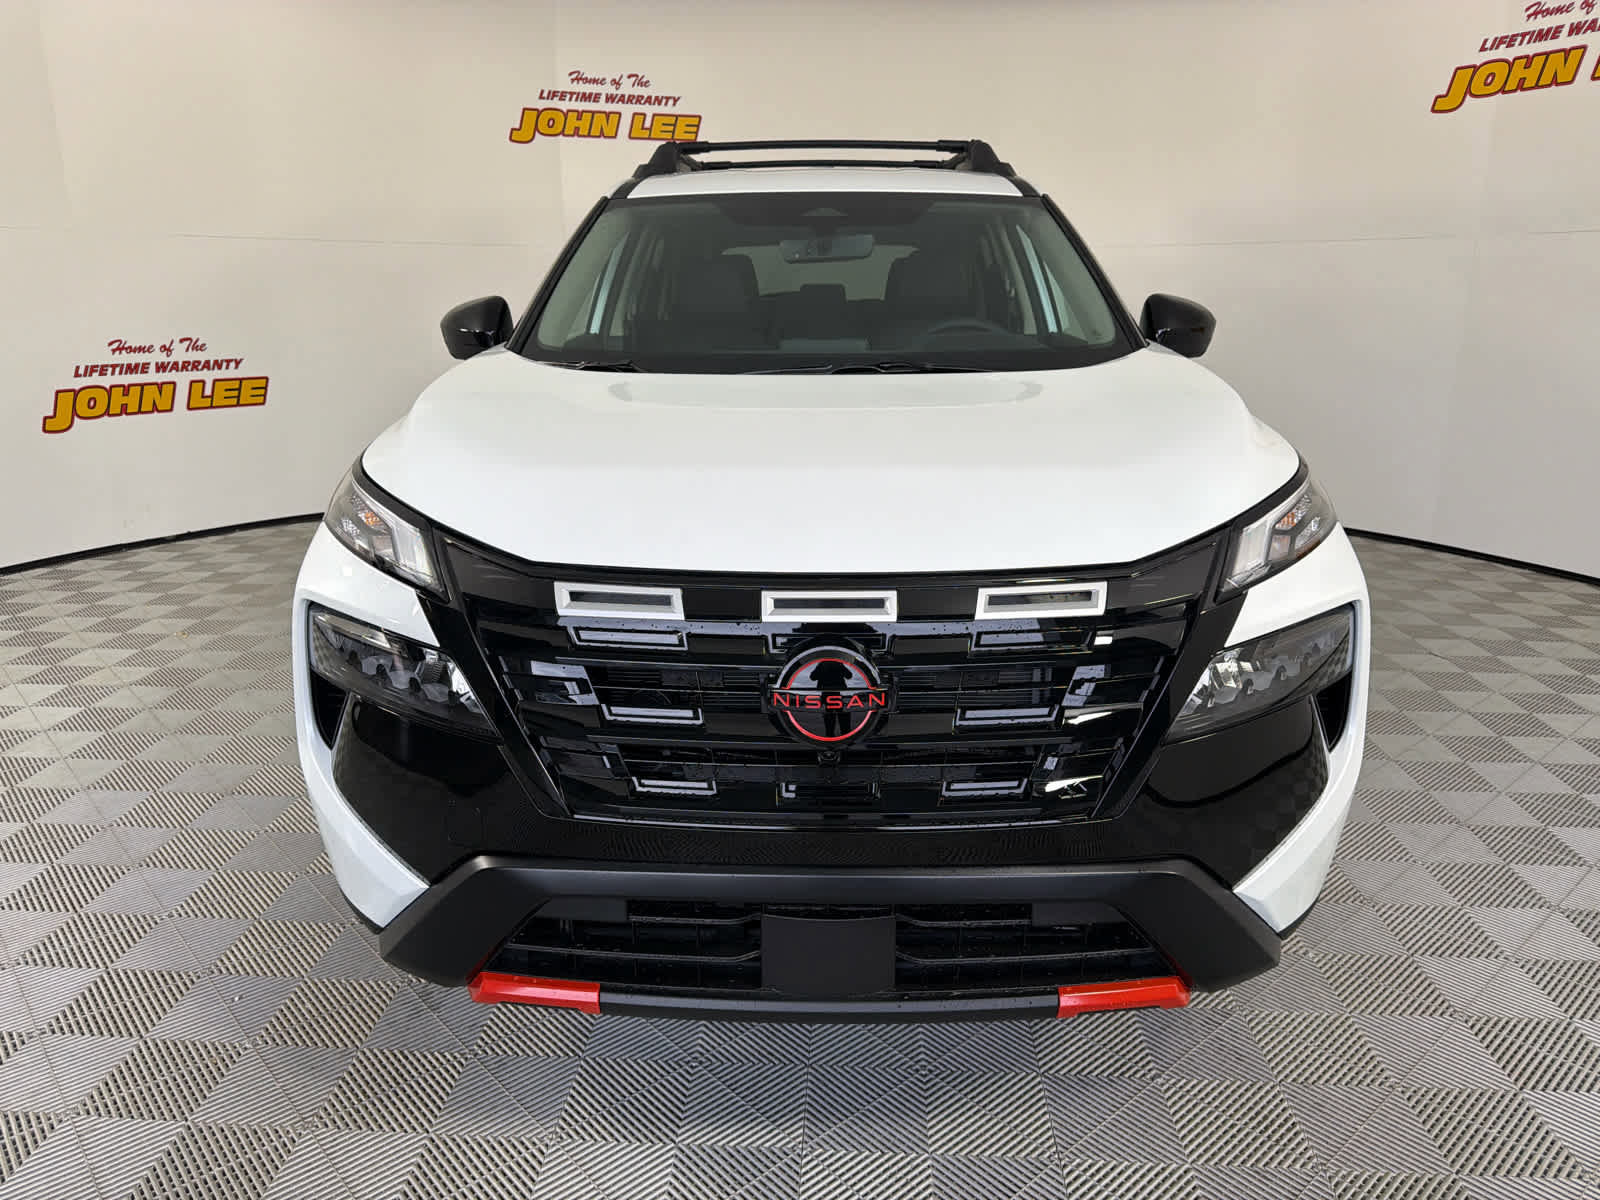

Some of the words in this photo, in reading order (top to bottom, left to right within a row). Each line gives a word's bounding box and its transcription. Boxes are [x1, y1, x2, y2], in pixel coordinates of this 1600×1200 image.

[1524, 1, 1575, 22] Home
[1478, 23, 1565, 53] LIFETIME
[1567, 17, 1600, 37] WA
[568, 70, 607, 86] Home
[610, 74, 624, 91] of
[627, 73, 651, 88] The
[1430, 44, 1588, 113] JOHN
[538, 89, 601, 103] LIFETIME
[604, 93, 681, 107] WARRANTY
[509, 107, 621, 144] JOHN
[628, 112, 702, 142] LEE
[107, 339, 155, 355] Home
[159, 339, 174, 357] of
[179, 337, 208, 353] The
[73, 362, 151, 378] LIFETIME
[154, 358, 244, 373] WARRANTY
[42, 381, 177, 433] JOHN
[186, 376, 269, 410] LEE
[773, 692, 885, 709] NISSAN
